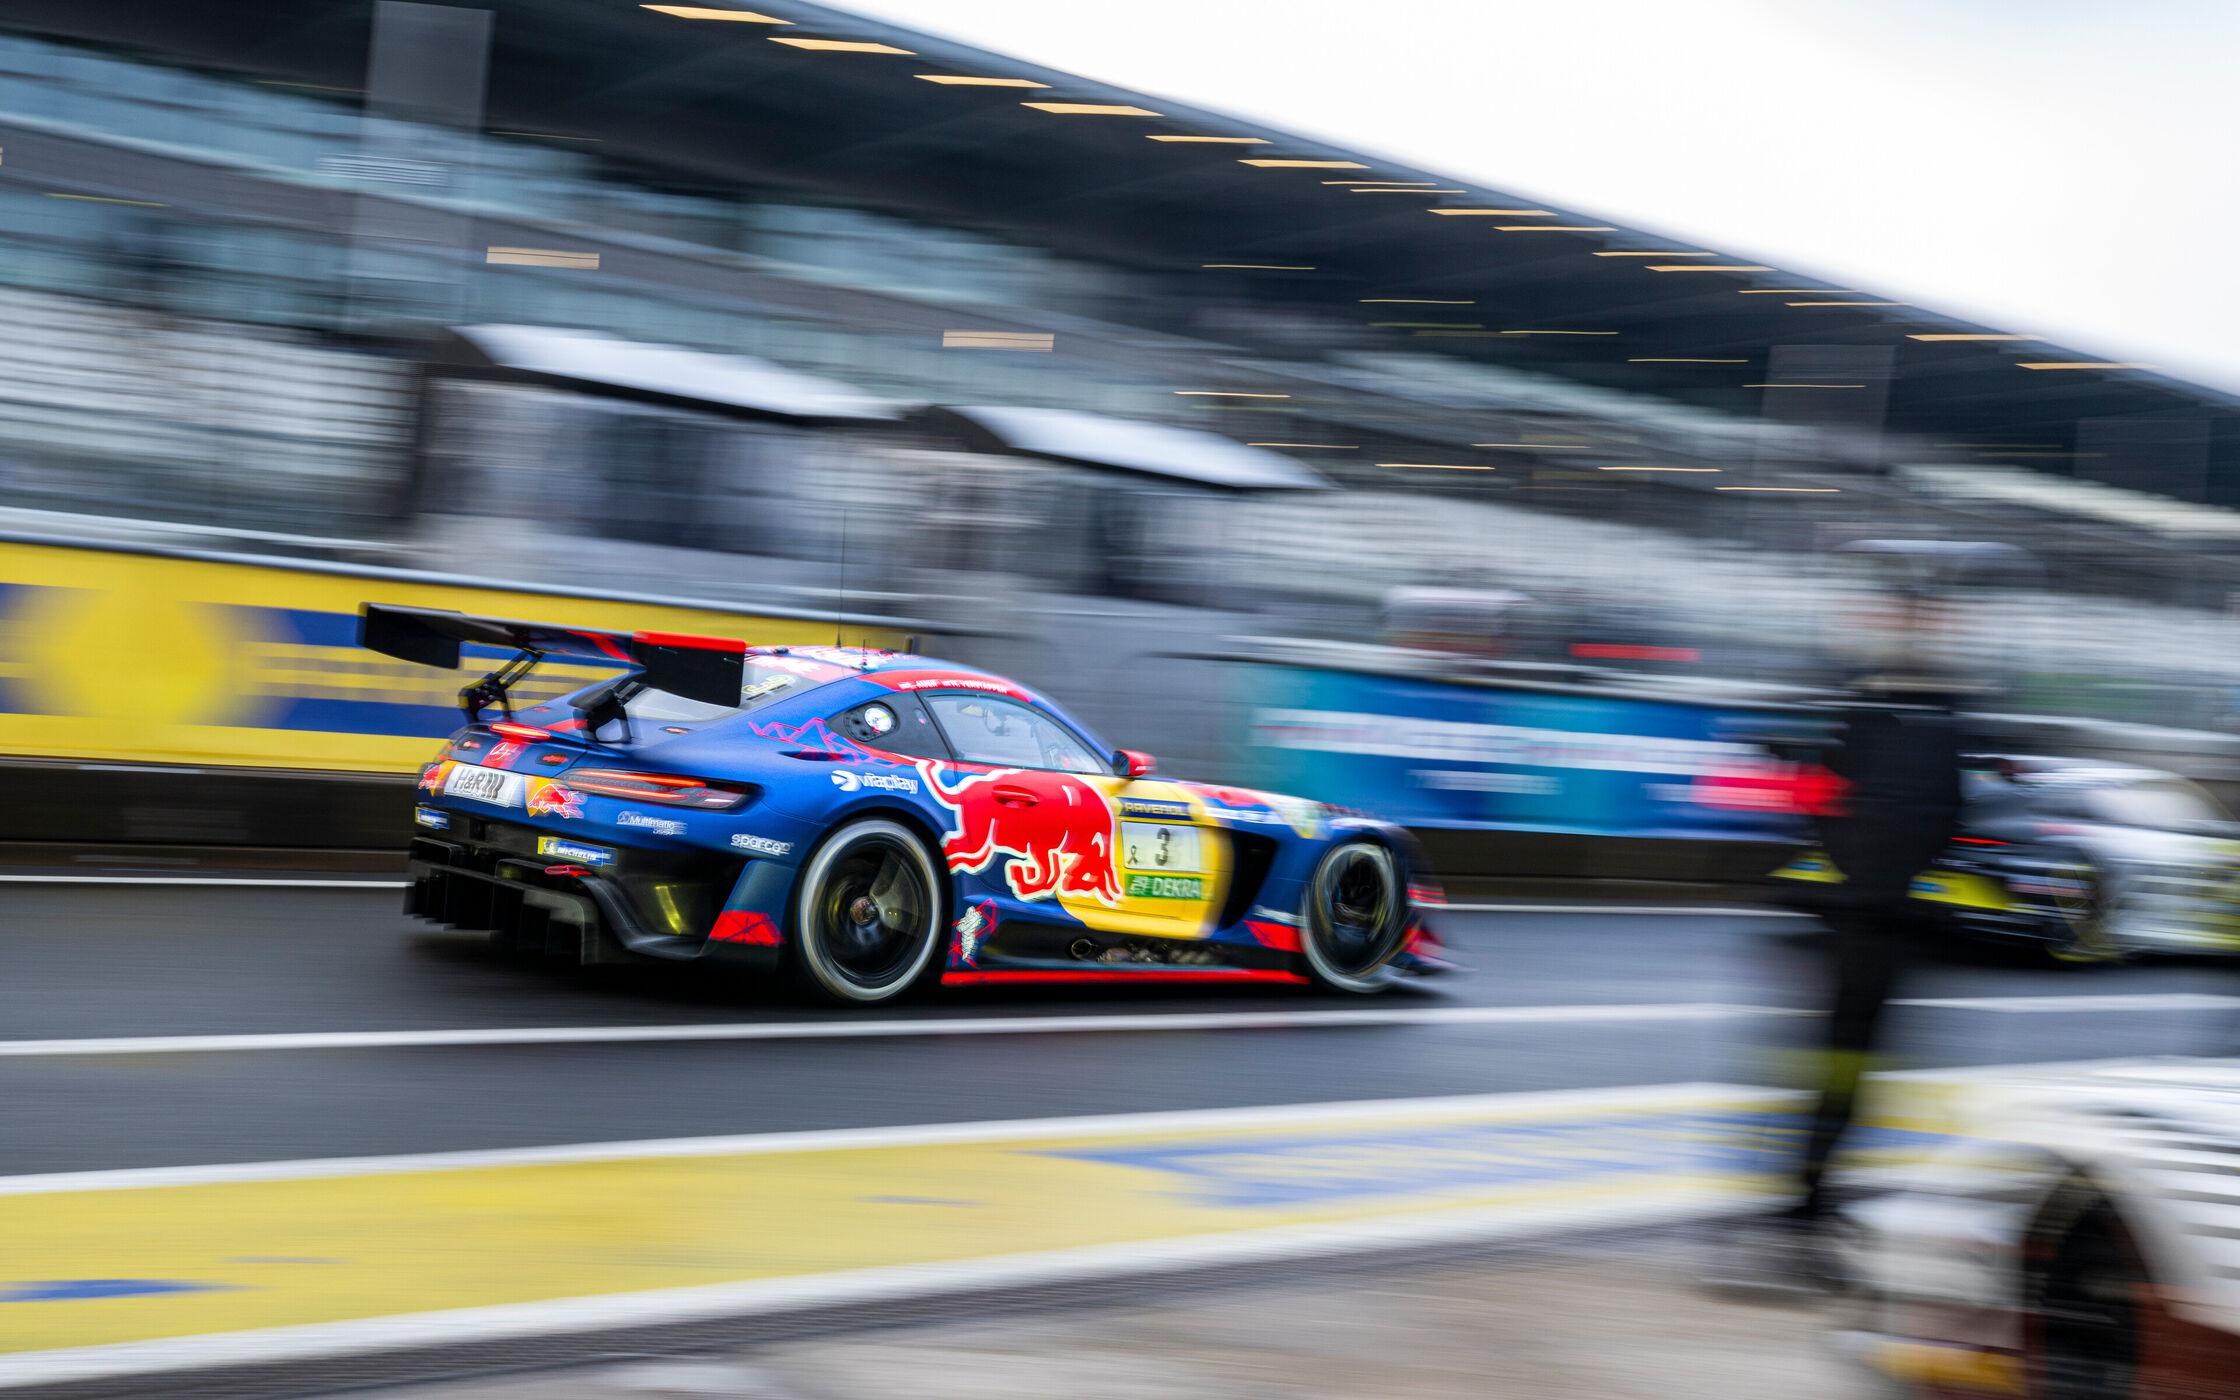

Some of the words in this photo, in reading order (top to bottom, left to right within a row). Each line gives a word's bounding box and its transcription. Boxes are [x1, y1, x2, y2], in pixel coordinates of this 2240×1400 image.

[453, 768, 486, 792] H&R
[557, 846, 598, 861] MICHELIN
[1154, 828, 1170, 866] 3
[1152, 877, 1201, 898] DEKRA
